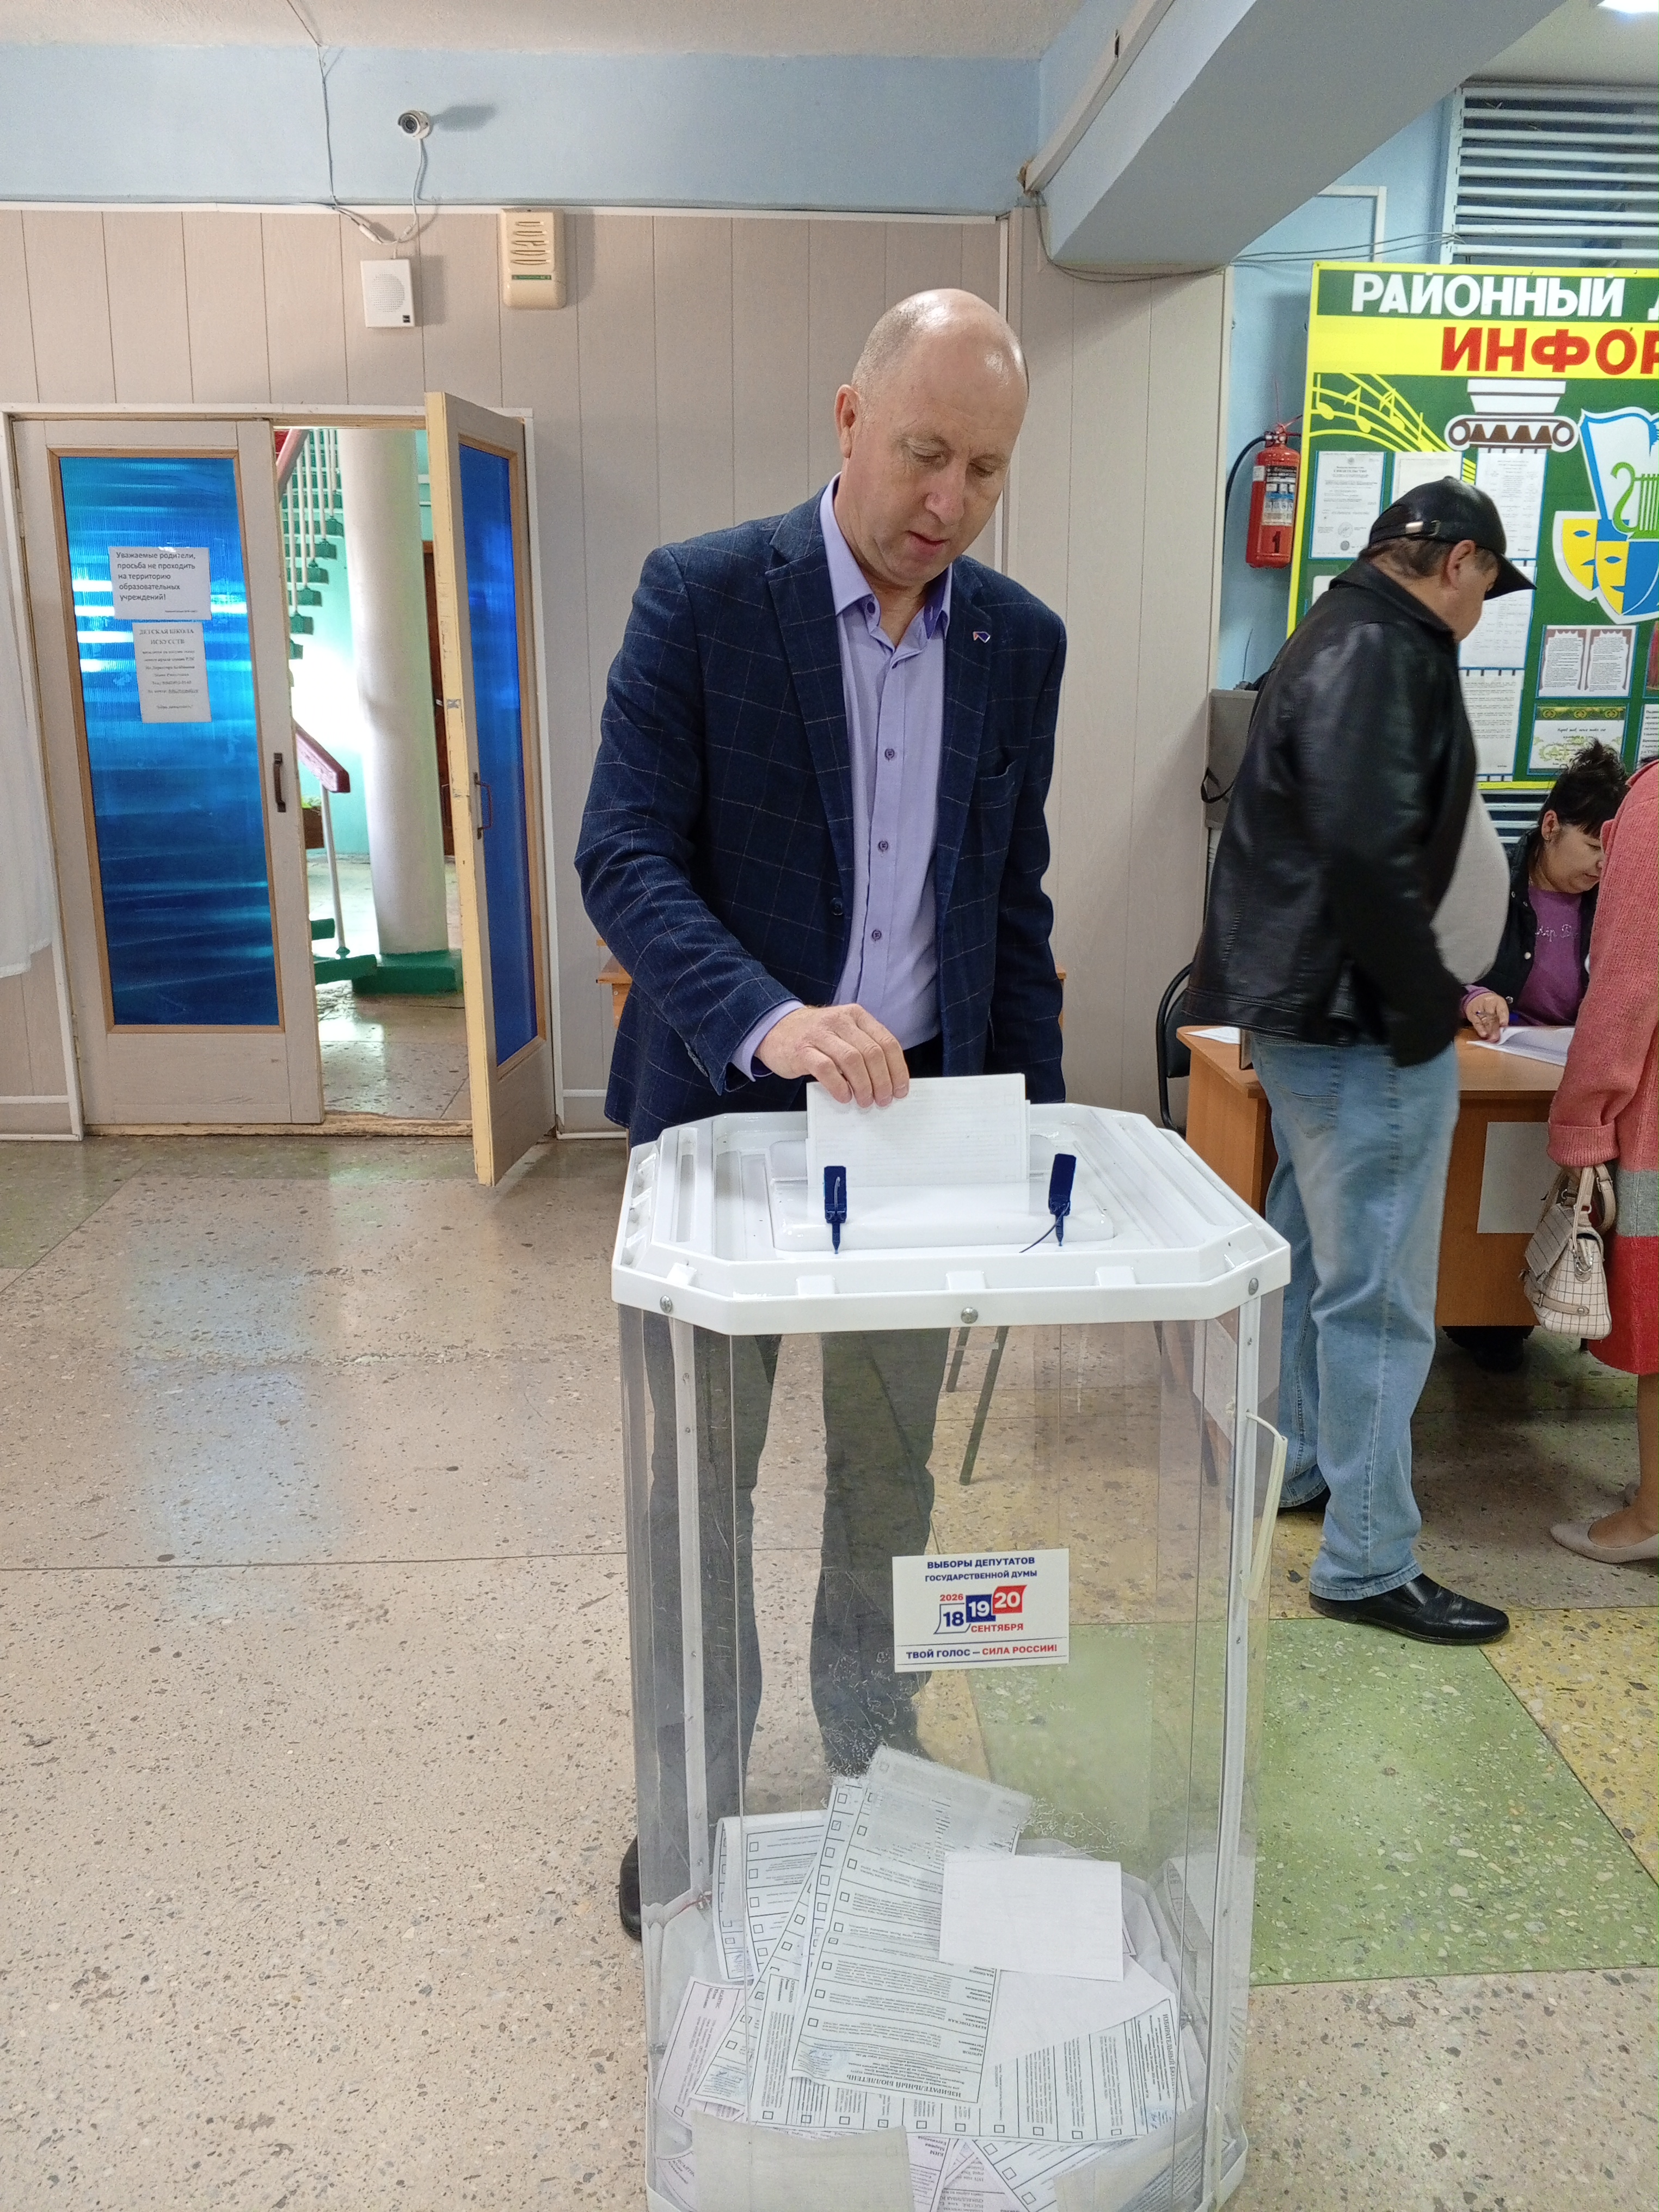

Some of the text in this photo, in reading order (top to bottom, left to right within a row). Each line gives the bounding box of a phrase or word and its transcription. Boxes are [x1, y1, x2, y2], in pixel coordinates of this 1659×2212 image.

[1351, 272, 1625, 318] РАЙОННЫЙ
[1272, 531, 1281, 553] 1
[927, 1557, 1035, 1569] ВЫБОРЫ ДЕПУТАТОВ
[925, 1570, 1037, 1582] ГОСУДАРСТВЕННОЙ ДУМЫ
[943, 1592, 1021, 1627] 18 19 20
[971, 1623, 1024, 1633] СЕНТЯБРЯ
[906, 1649, 934, 1660] ТВОЙ
[936, 1649, 970, 1658] ГОЛОС
[982, 1645, 1010, 1655] СИЛА
[1013, 1644, 1058, 1654] РОССИИ!
[1162, 2014, 1174, 2065] ИЗБИРАТЕЛЬНЫЙ
[846, 2073, 961, 2098] ИЗБИРАТЕЛЬНЫЙ БЮЛЛЕТЕНЬ
